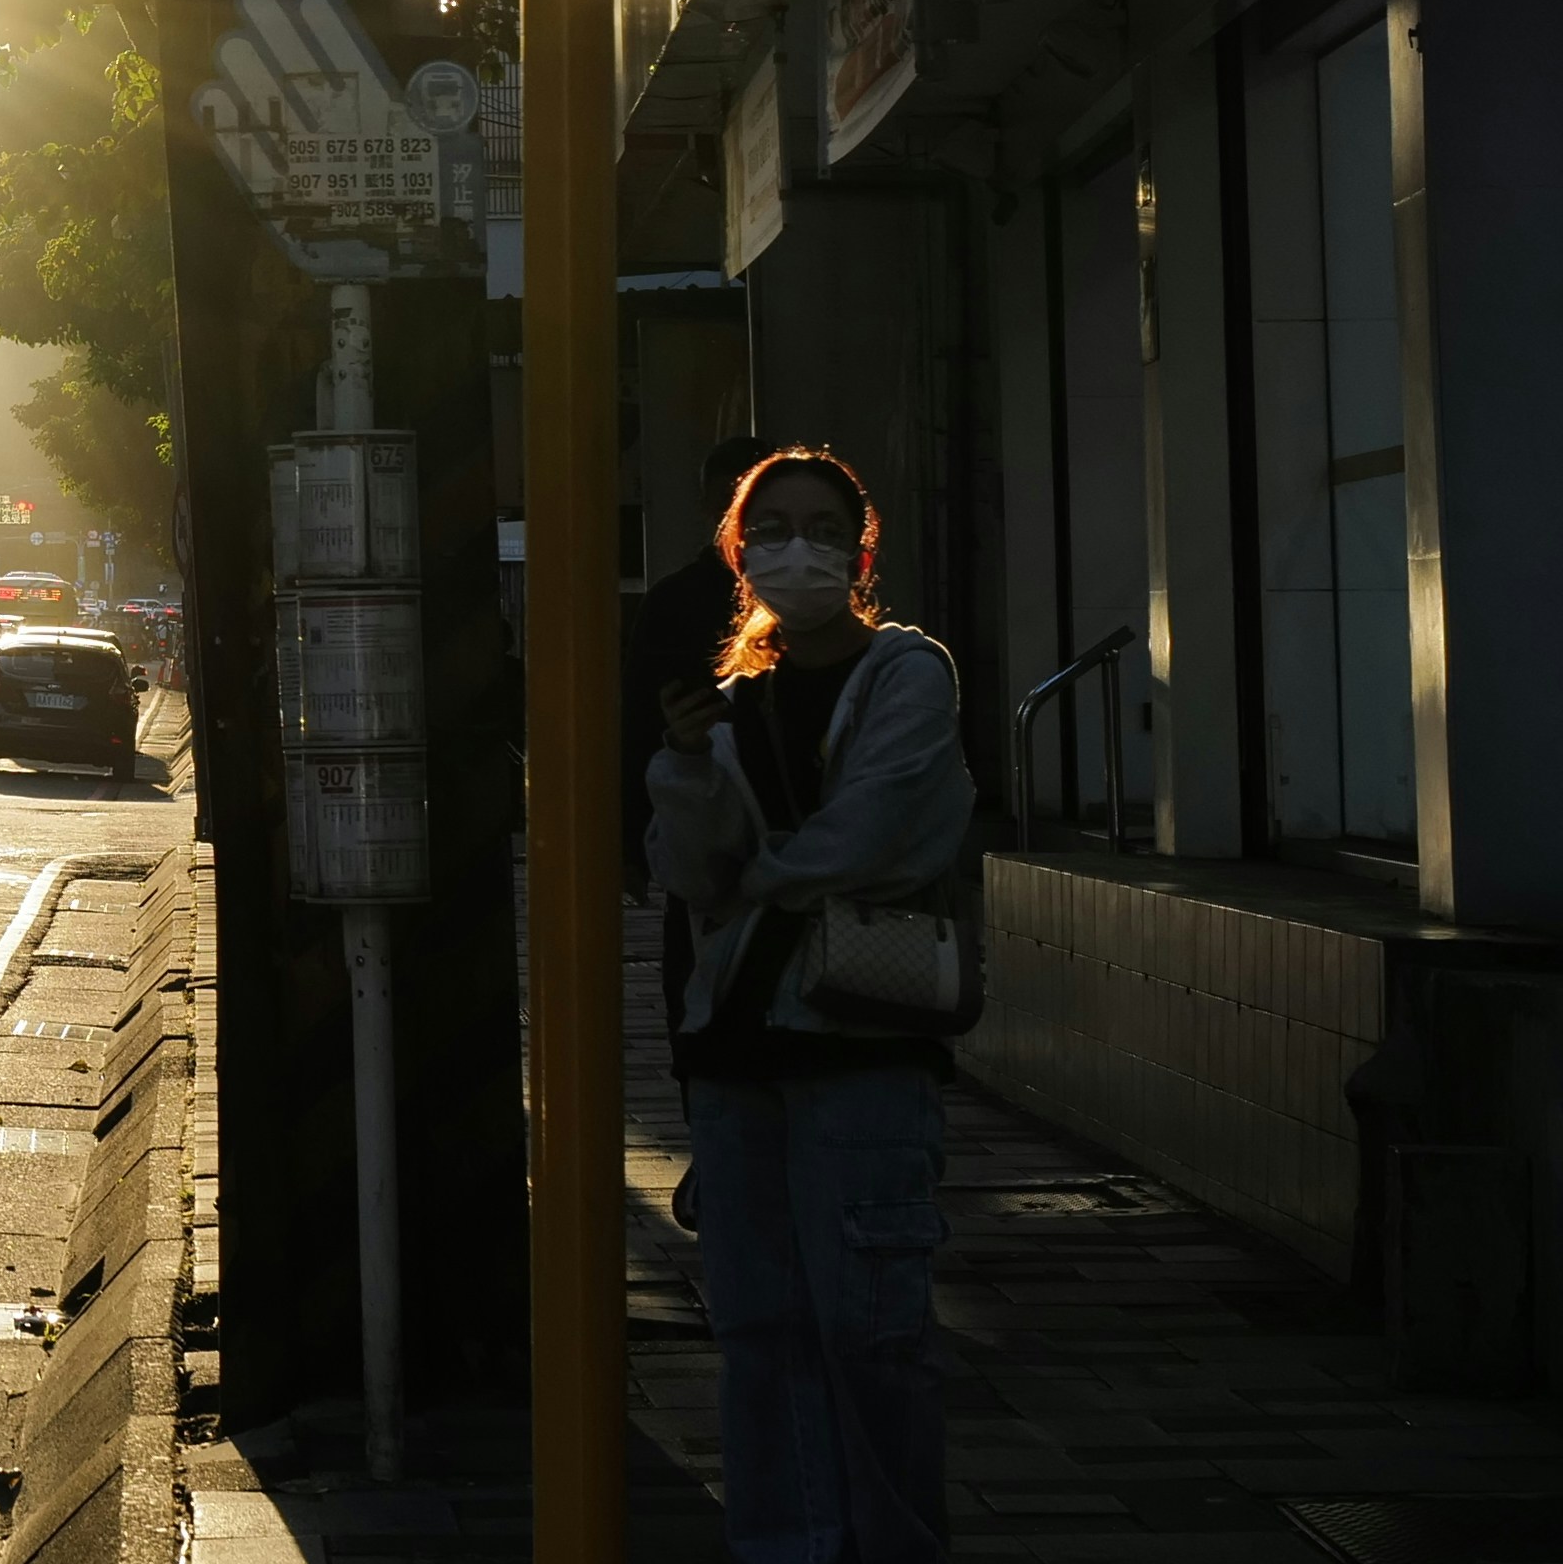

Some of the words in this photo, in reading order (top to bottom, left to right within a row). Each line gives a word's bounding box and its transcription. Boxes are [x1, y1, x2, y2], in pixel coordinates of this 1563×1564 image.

[326, 139, 358, 154] 675
[363, 138, 395, 154] 678
[400, 138, 431, 153] 823
[290, 174, 321, 189] 907
[327, 174, 358, 188] 951
[401, 172, 433, 187] 1031
[364, 202, 395, 216] 589
[370, 445, 405, 466] 675
[318, 766, 356, 787] 907
